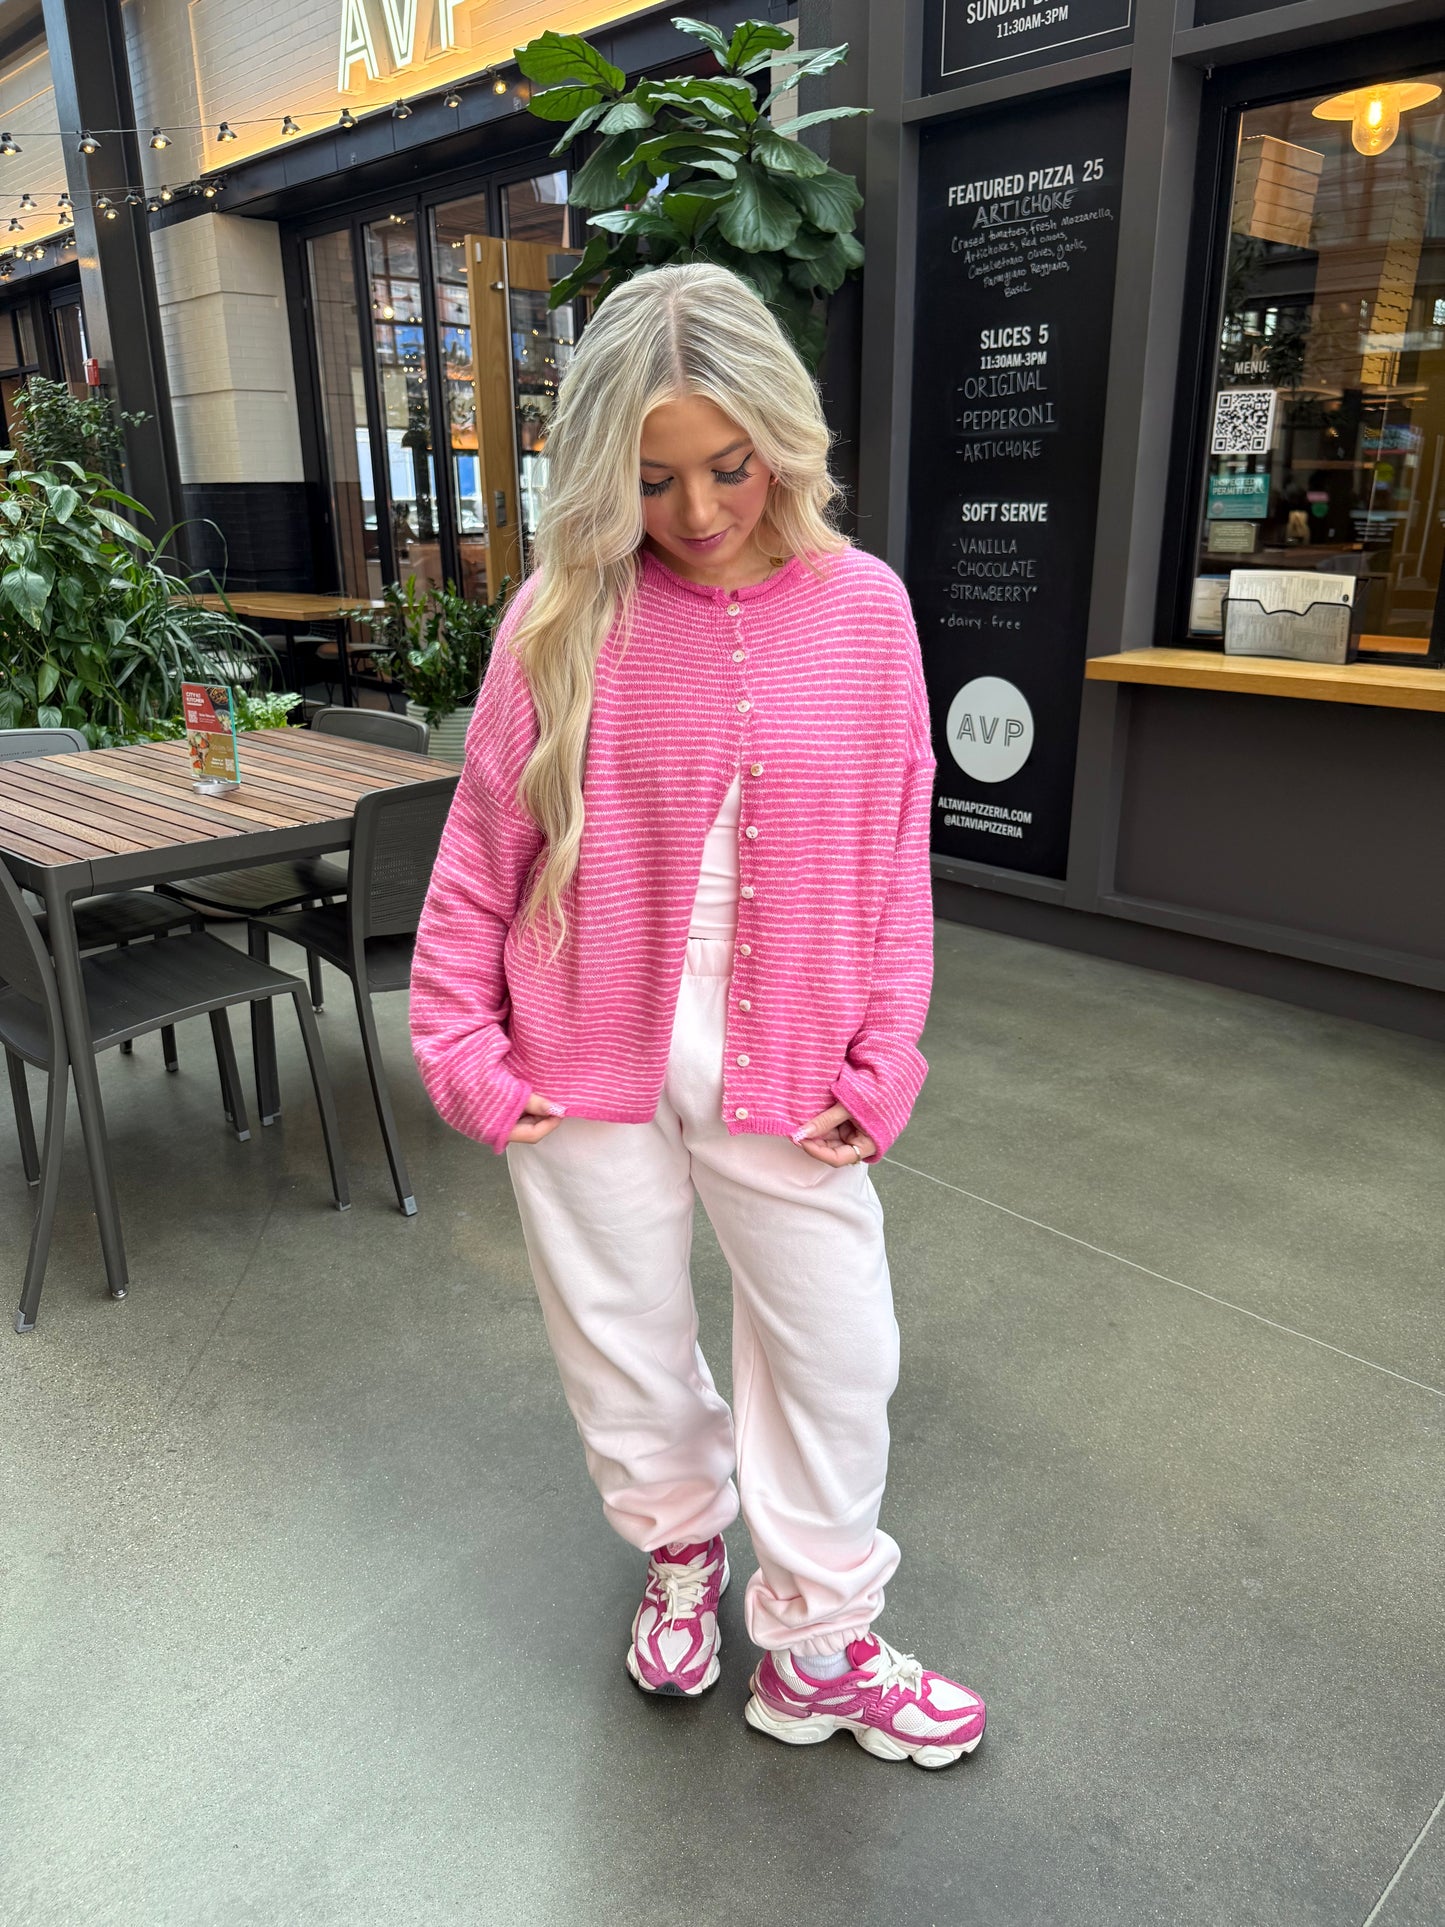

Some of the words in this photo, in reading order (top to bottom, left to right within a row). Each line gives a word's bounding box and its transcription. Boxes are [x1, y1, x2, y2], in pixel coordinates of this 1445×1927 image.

[996, 5, 1069, 38] 11:30AM-3PM
[948, 174, 1024, 207] FEATURED
[1028, 164, 1074, 192] PIZZA
[1082, 158, 1104, 182] 25
[972, 188, 1077, 229] ARTICHOKE
[1029, 220, 1057, 235] fresh
[964, 242, 1018, 264] Artichokes,
[980, 326, 1031, 350] SLICES
[1039, 324, 1049, 344] 5
[980, 351, 1047, 369] 11:30AM-3PM
[1234, 360, 1271, 375] MENU:
[957, 370, 1048, 399] -ORIGINAL
[956, 402, 1055, 430] -PEPPERONI
[956, 440, 1042, 463] -ARTICHOKE
[962, 503, 998, 522] SOFT
[1000, 503, 1048, 522] SERVE
[957, 713, 1024, 747] AVP
[938, 796, 1033, 824] ALTAVIAPIZZERIA.COM
[943, 814, 1023, 839] @ALTAVIAPIZZERIA
